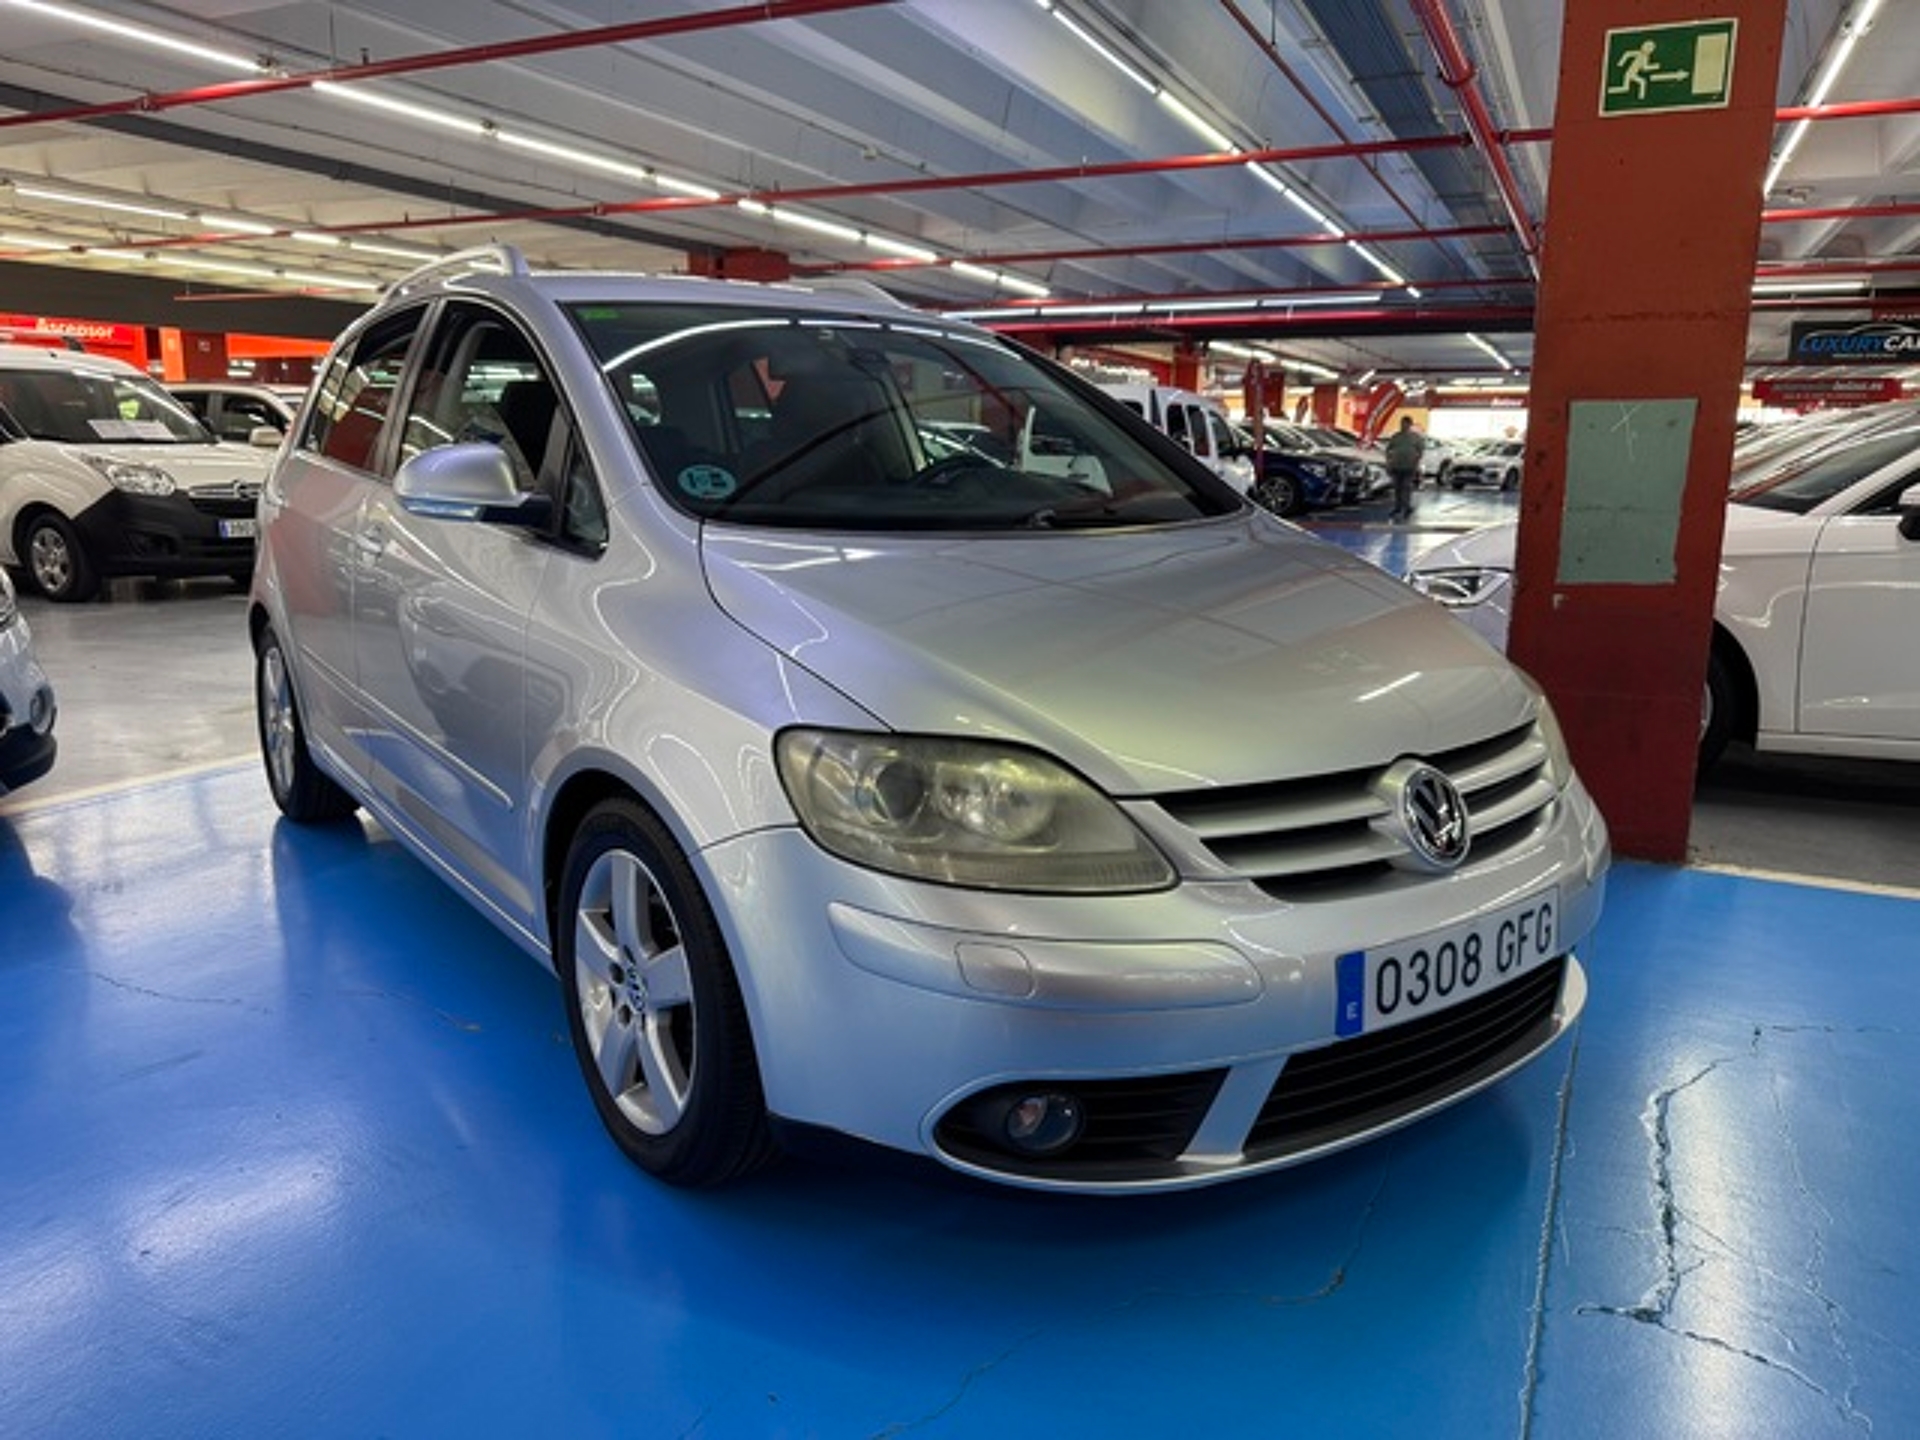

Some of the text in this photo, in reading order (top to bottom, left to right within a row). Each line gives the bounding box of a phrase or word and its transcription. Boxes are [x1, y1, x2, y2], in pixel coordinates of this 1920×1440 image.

[1798, 334, 1920, 352] LUXURYCA
[1376, 902, 1552, 1015] 0308 GFG
[1346, 1001, 1358, 1022] E
